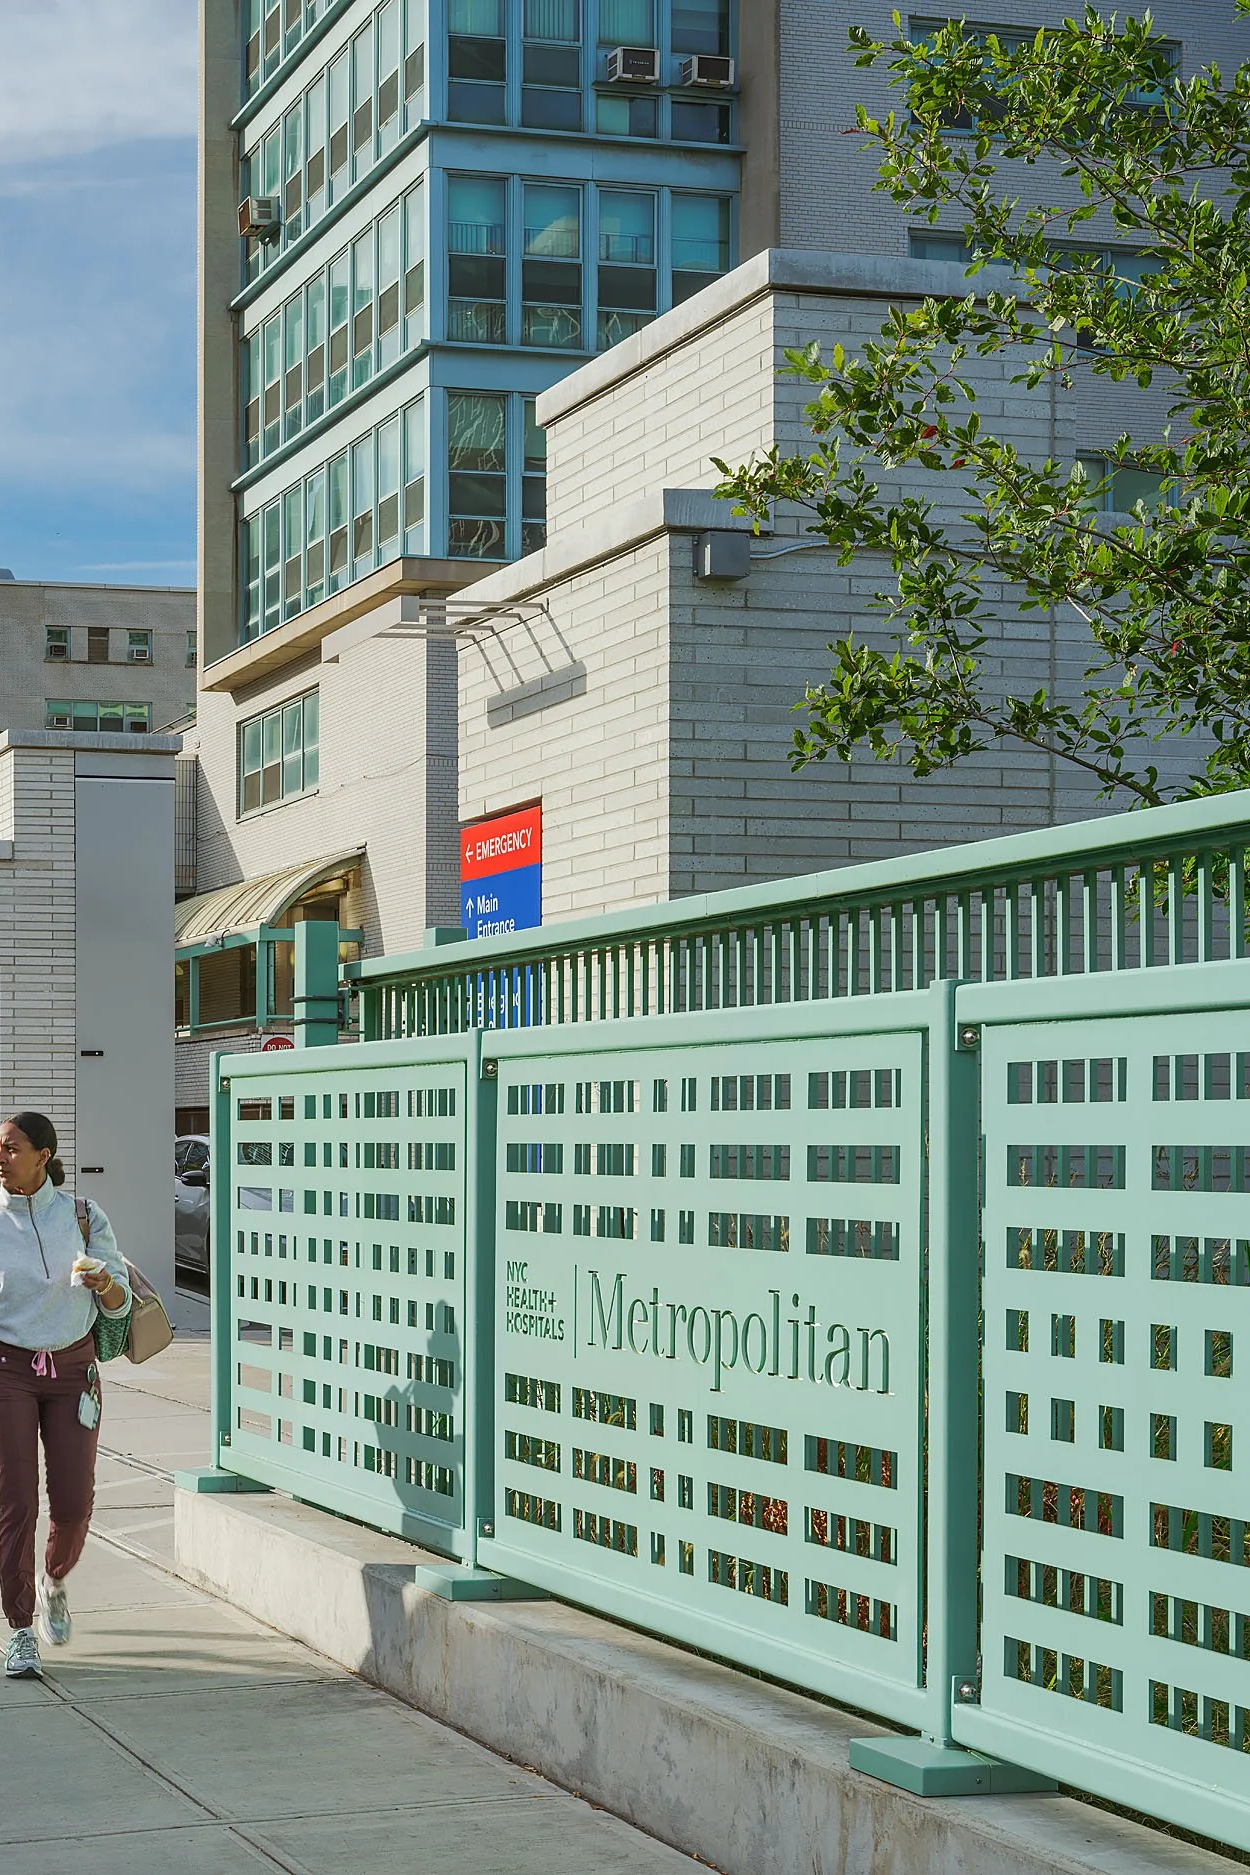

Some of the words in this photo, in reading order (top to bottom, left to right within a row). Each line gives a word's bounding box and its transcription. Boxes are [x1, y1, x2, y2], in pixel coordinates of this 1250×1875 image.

[476, 827, 532, 861] EMERGENCY
[477, 893, 498, 915] Main
[477, 918, 515, 939] Entrance
[506, 1260, 529, 1283] NYC
[506, 1285, 557, 1314] HEALTH+
[506, 1311, 565, 1341] HOSPITALS
[587, 1270, 896, 1396] Metropolitan
